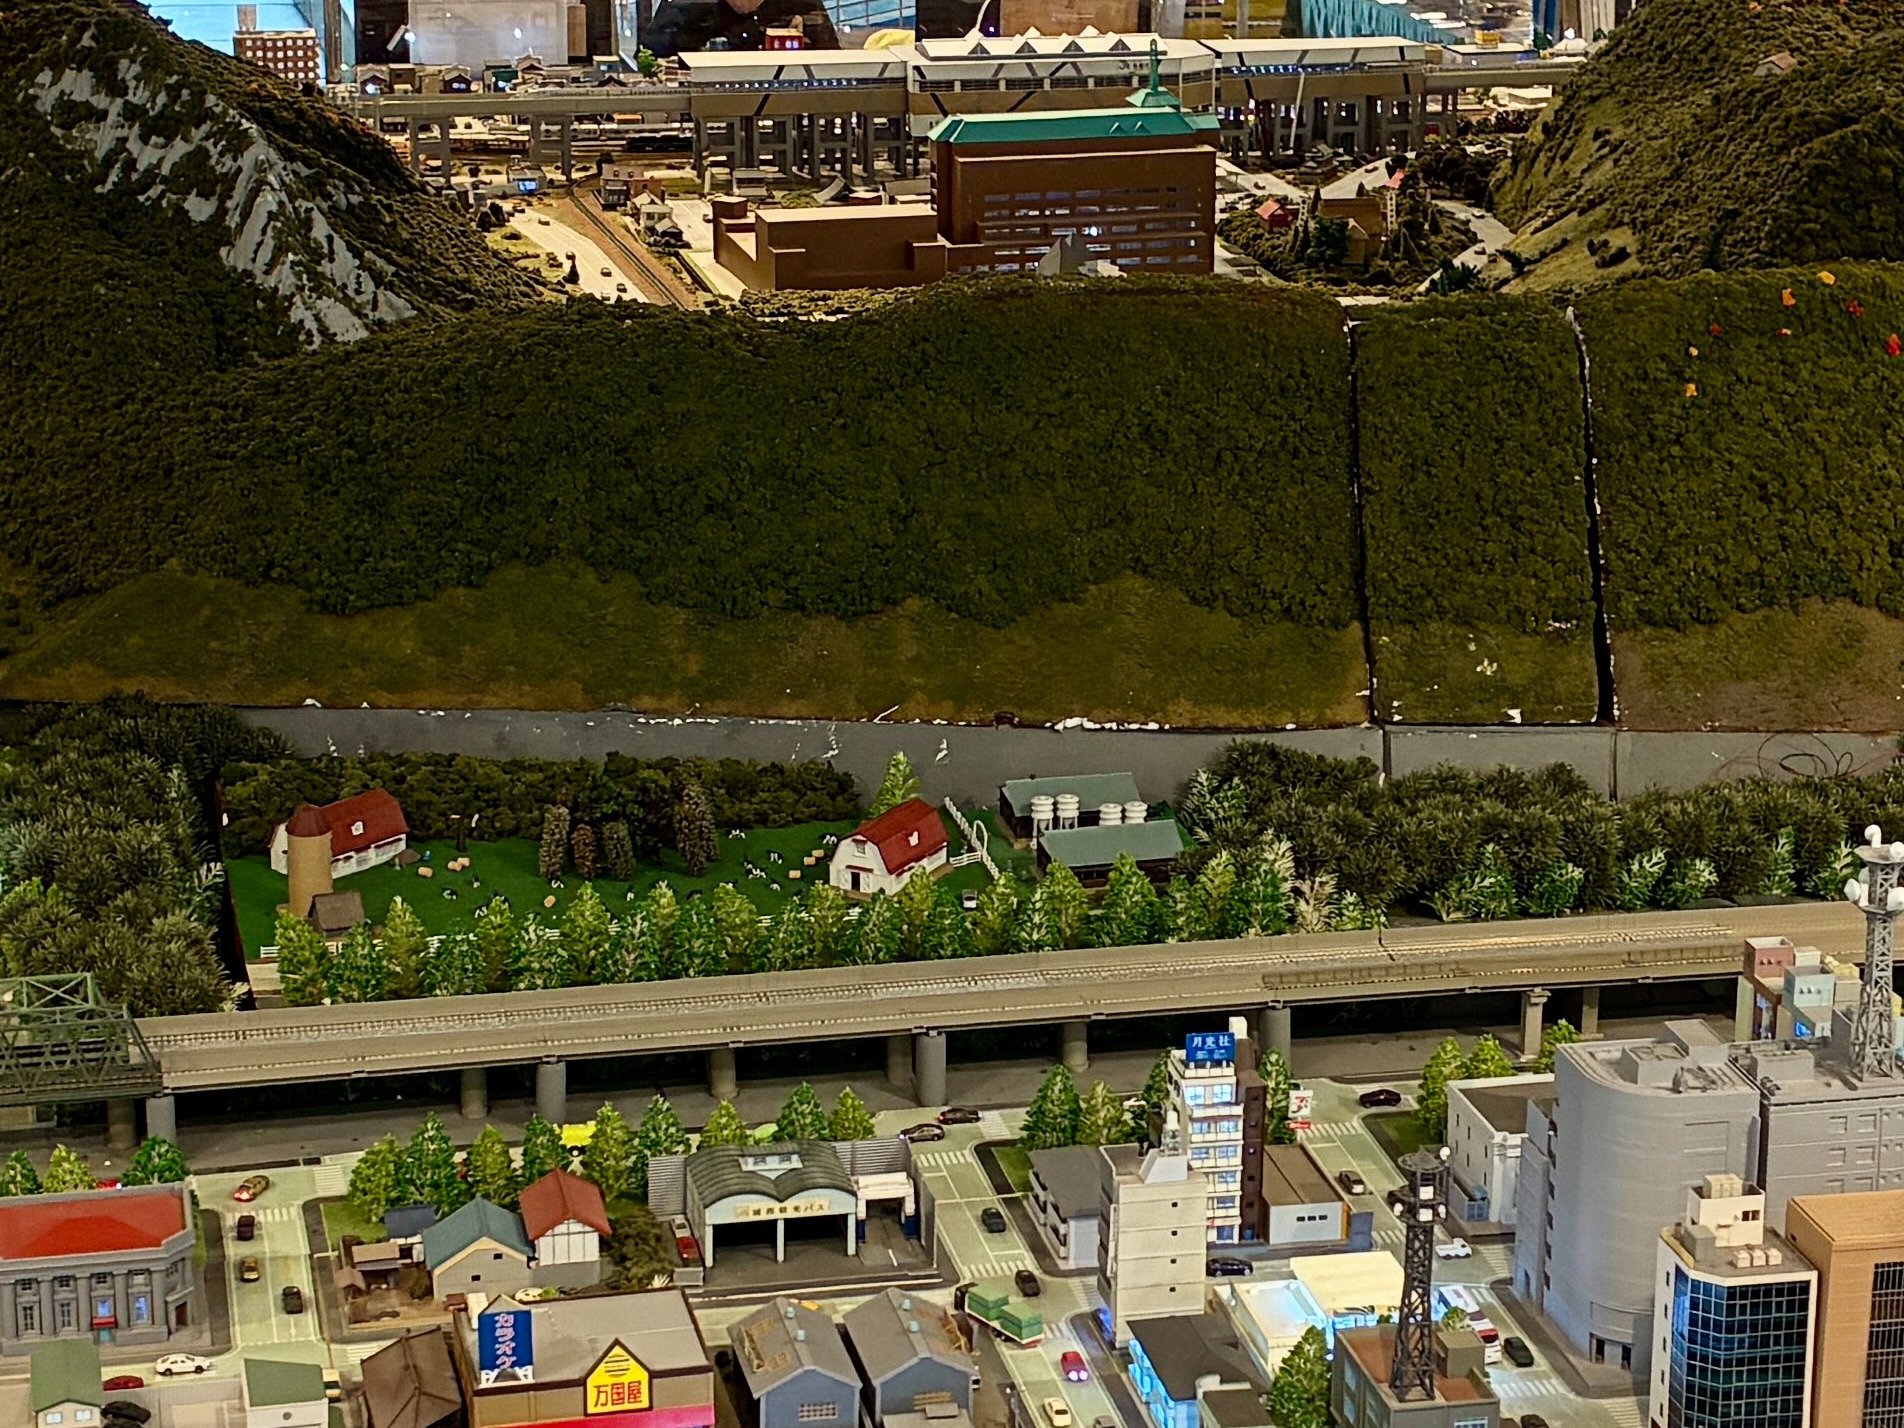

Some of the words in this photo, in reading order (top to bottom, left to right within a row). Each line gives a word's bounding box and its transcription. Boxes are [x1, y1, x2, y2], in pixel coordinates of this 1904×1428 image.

[494, 1313, 517, 1369] カラオケ
[593, 1380, 643, 1408] 万国屋
